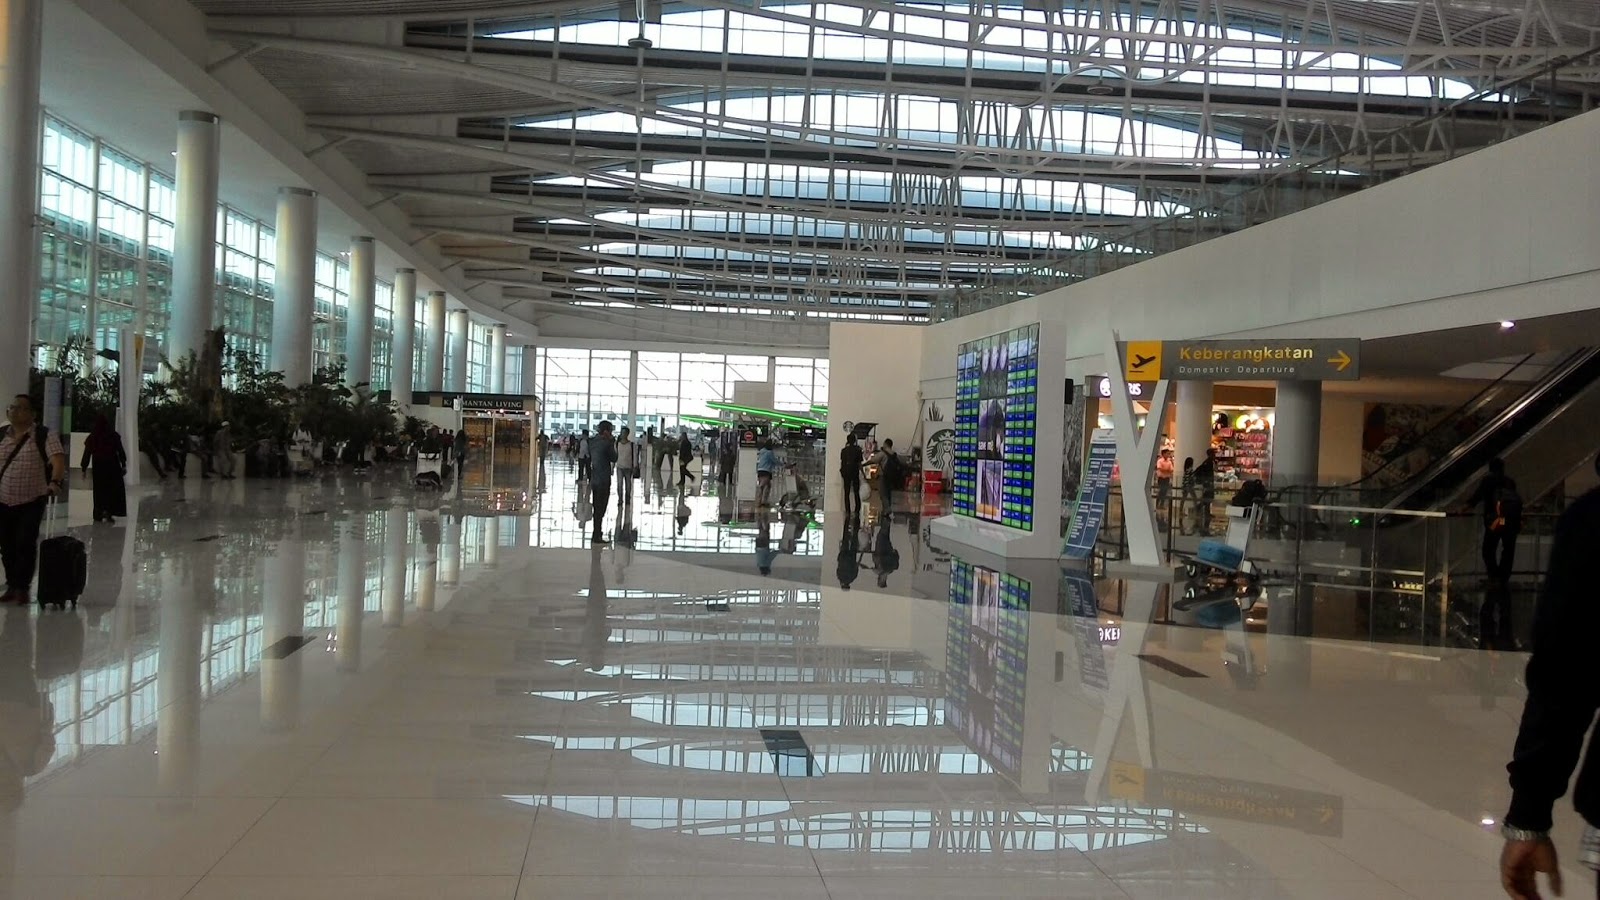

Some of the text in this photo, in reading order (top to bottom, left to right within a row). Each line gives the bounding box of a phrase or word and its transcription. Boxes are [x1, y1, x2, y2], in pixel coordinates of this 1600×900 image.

[1179, 346, 1314, 362] Keberangkatan
[1179, 365, 1295, 374] Domestic Departure
